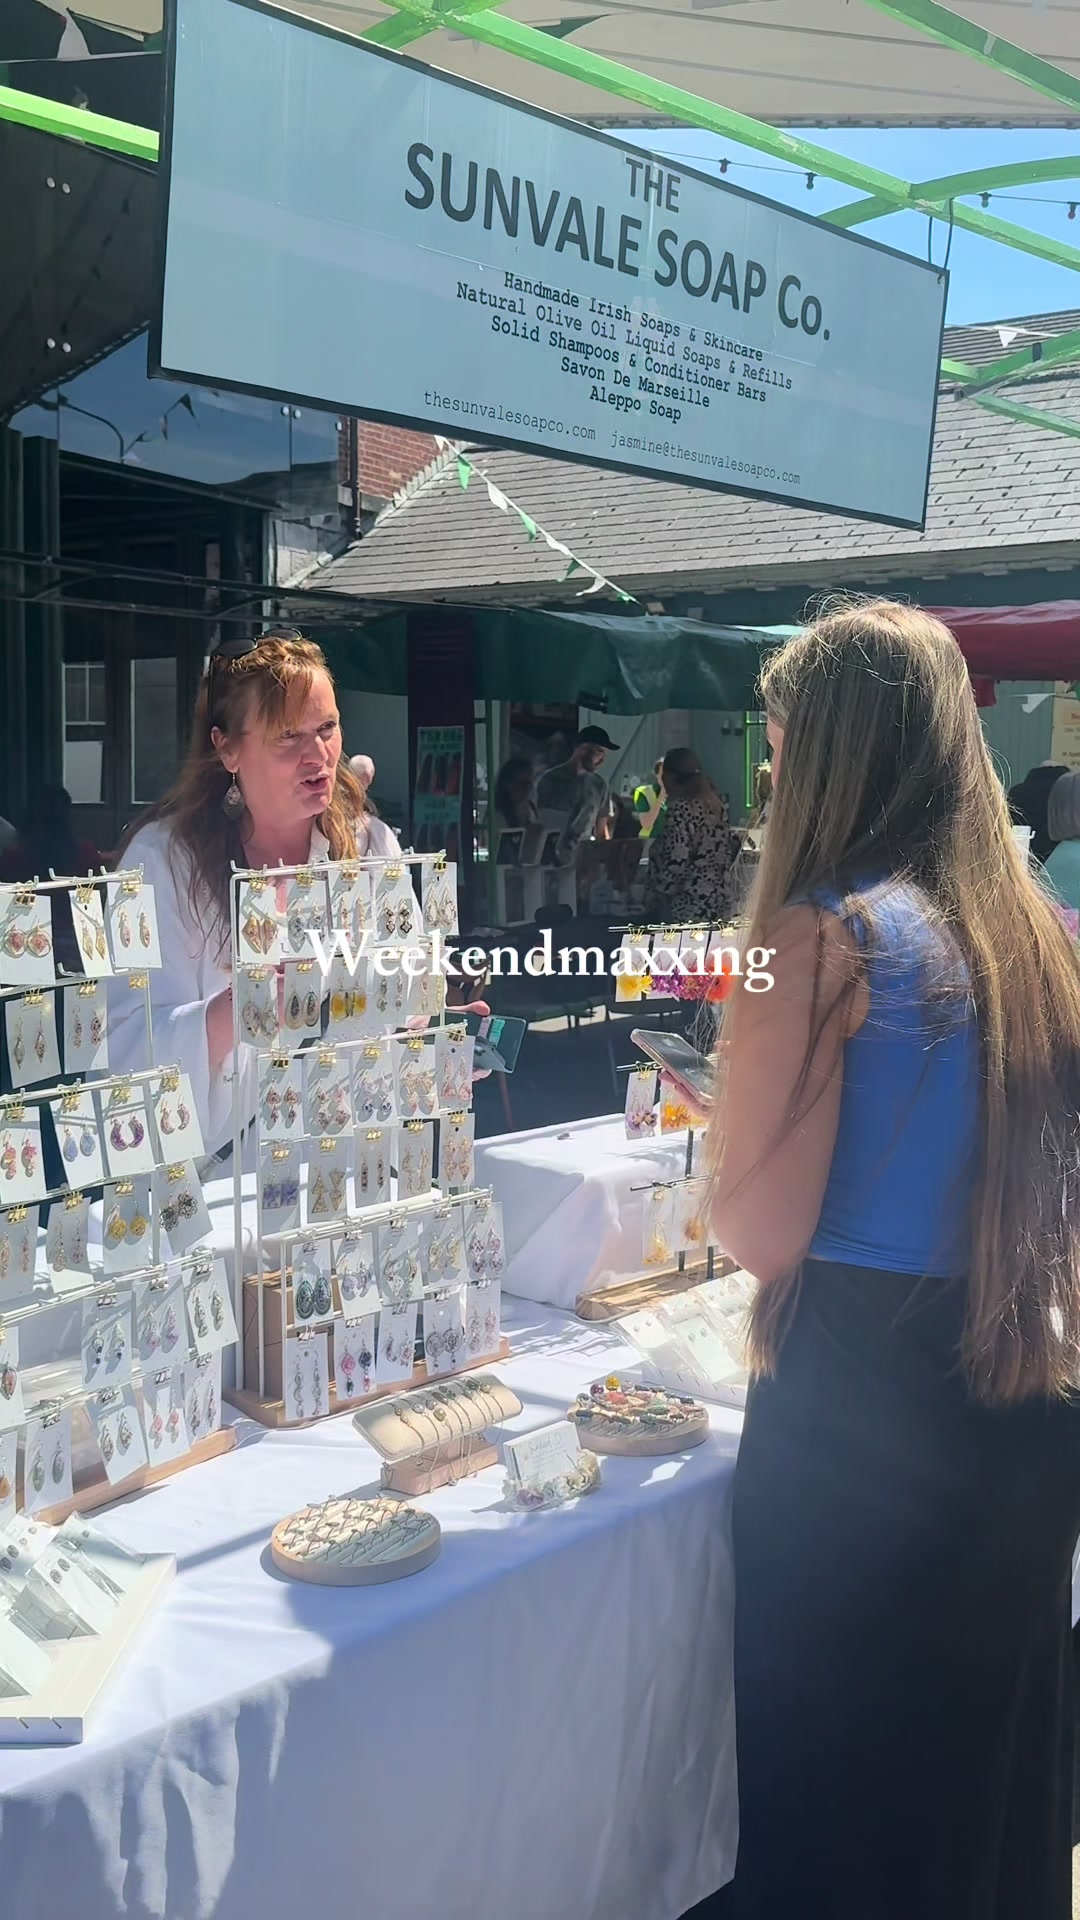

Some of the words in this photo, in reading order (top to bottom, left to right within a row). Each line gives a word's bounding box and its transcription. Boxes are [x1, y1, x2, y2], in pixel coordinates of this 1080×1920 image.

[625, 157, 682, 213] THE
[404, 142, 643, 278] SUNVALE
[654, 229, 767, 314] SOAP
[777, 274, 831, 338] Co.
[456, 281, 526, 316] Natural
[535, 304, 583, 331] Olive
[590, 320, 617, 341] Oil
[625, 329, 676, 358] Liquid
[682, 345, 721, 372] Soaps
[728, 360, 737, 374] &
[742, 361, 793, 390] Refills
[490, 315, 540, 343] Solid
[548, 331, 620, 365] Shampoos
[628, 353, 637, 368] &
[644, 357, 731, 393] Conditioner
[737, 381, 767, 403] Bars
[504, 271, 580, 307] Handmade
[588, 296, 632, 323] Irish
[640, 312, 681, 338] Soaps
[688, 327, 697, 342] &
[703, 331, 764, 362] Skincare
[560, 356, 606, 381] Savon
[613, 370, 632, 387] De
[638, 376, 711, 408] Marseille
[589, 386, 642, 413] Aleppo
[649, 399, 682, 424] Soap
[424, 390, 597, 441] thesunvalesoapco.com
[610, 430, 801, 485] jasmine@thesunvalesoapco.com
